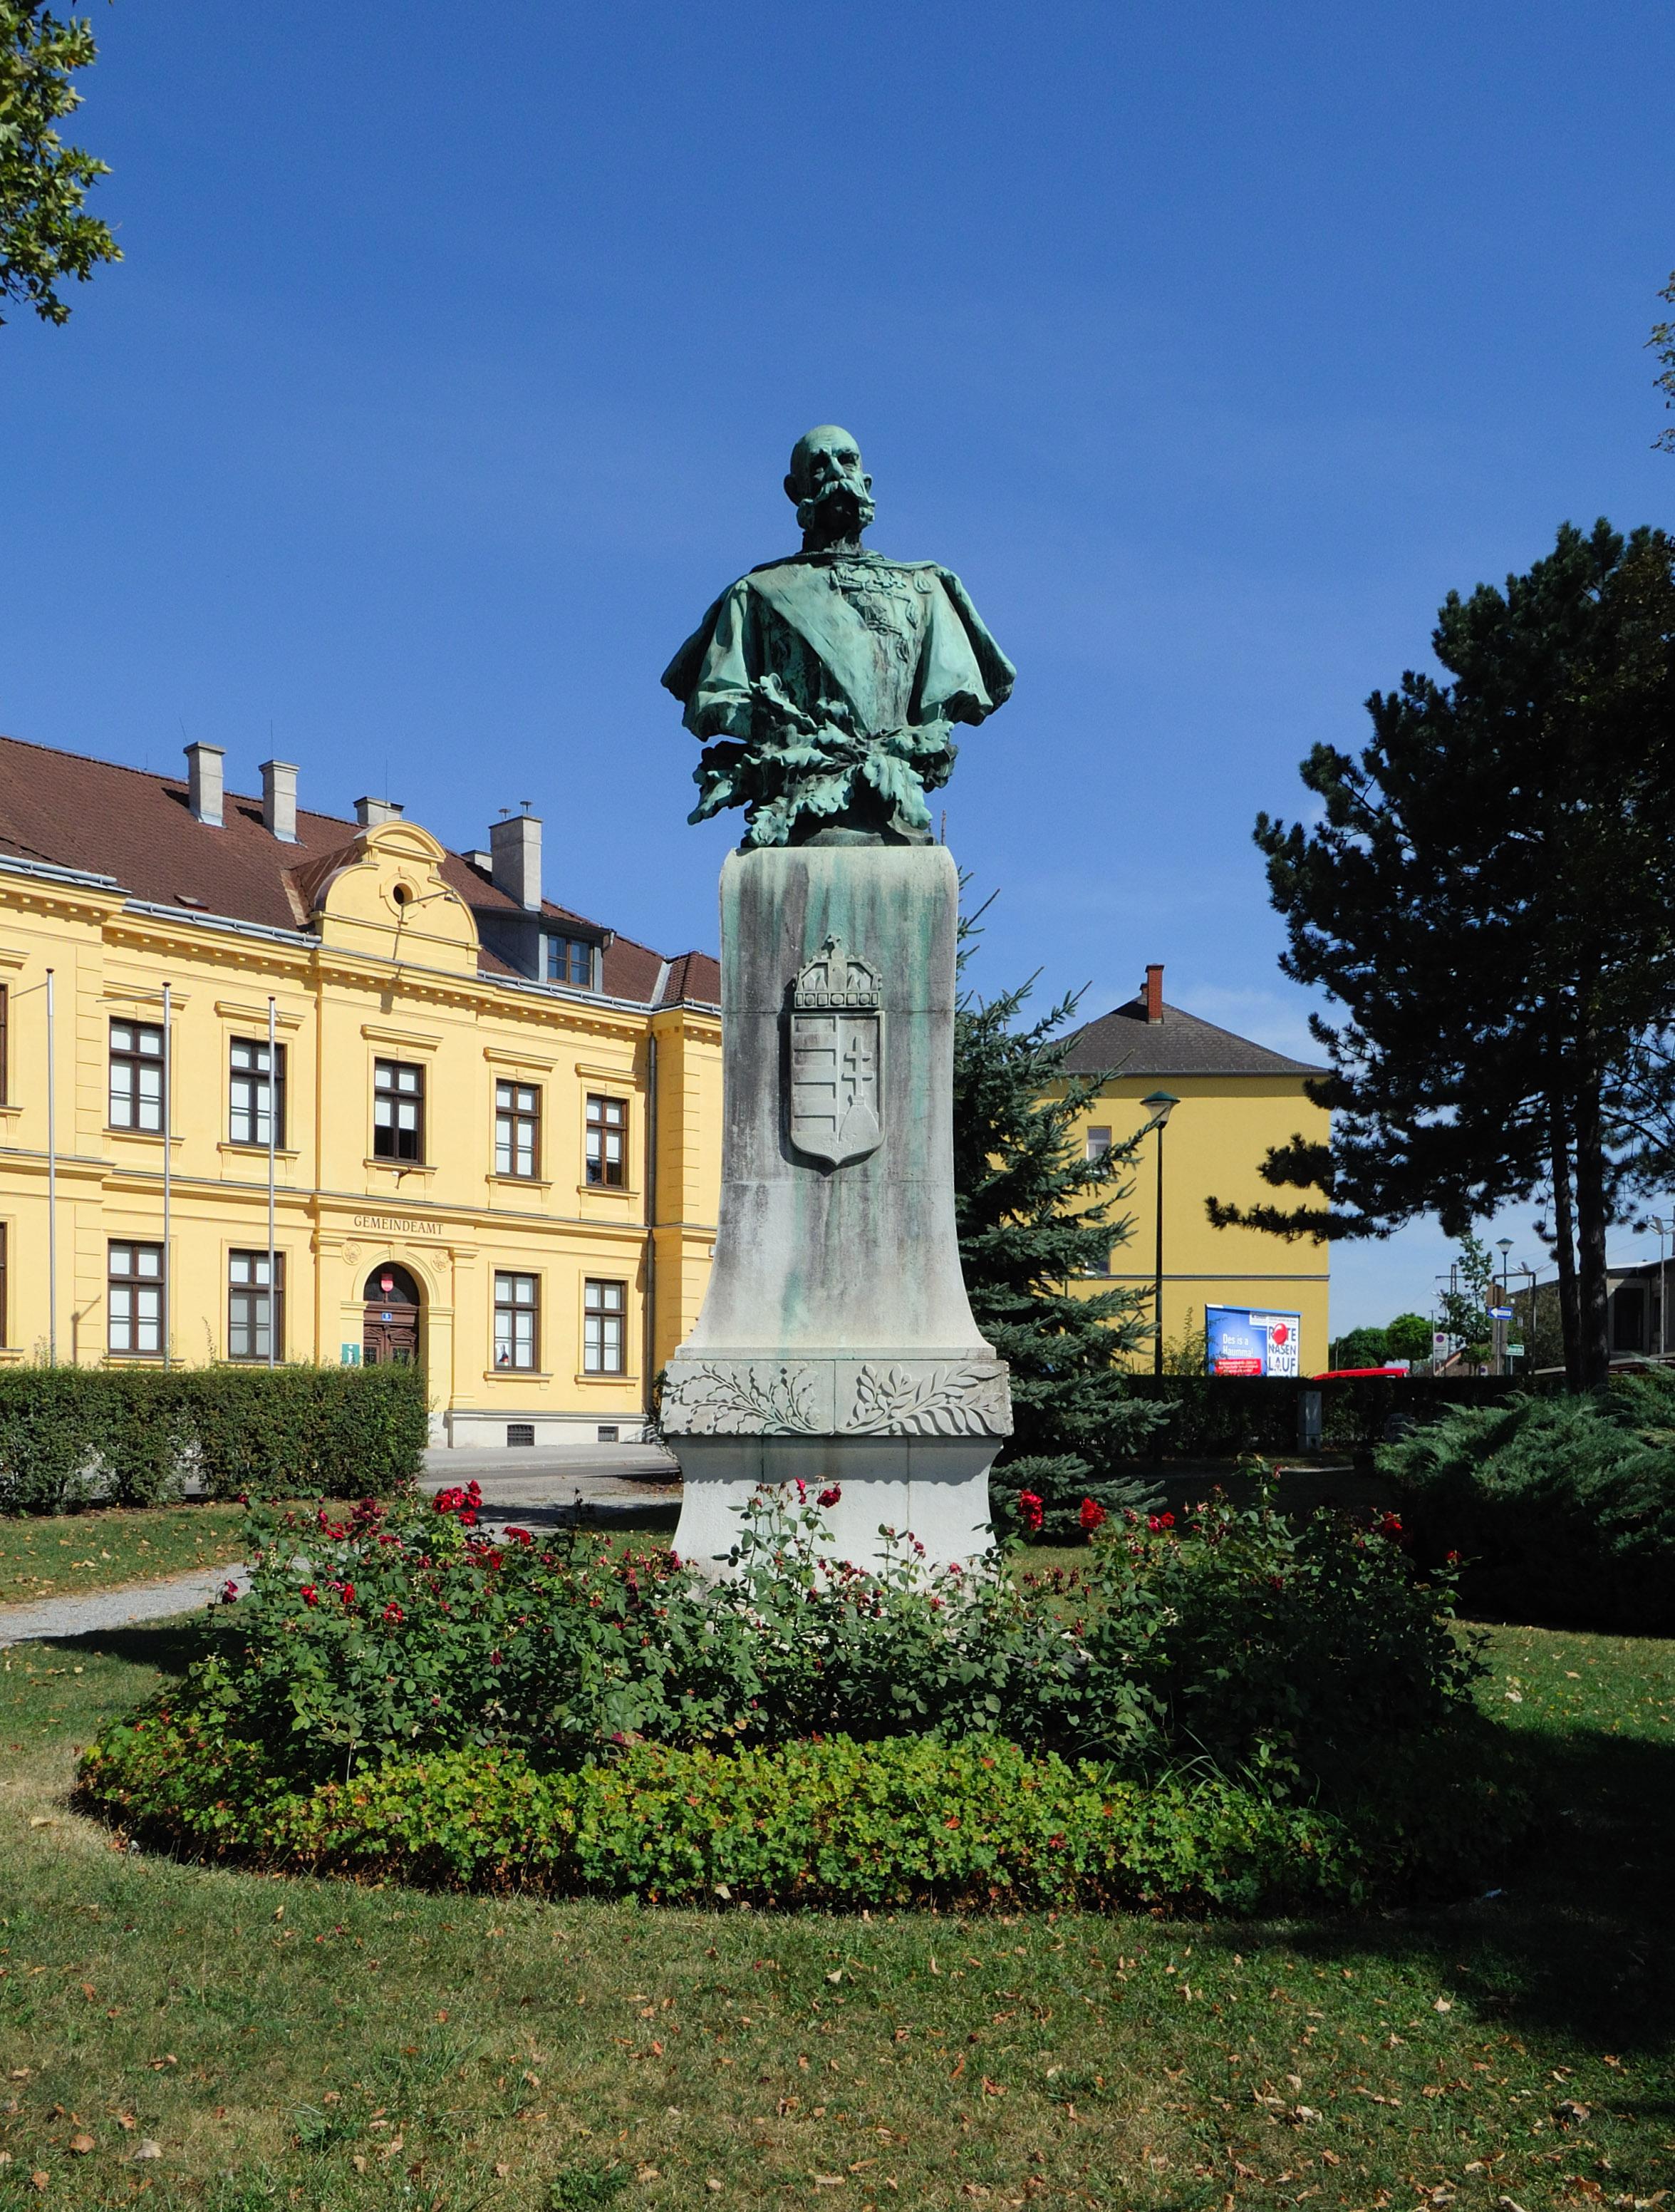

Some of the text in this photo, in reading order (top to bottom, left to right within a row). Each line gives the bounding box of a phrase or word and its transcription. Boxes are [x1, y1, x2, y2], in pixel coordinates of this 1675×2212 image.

[354, 1215, 443, 1235] GEMEINDEAMT
[1223, 1333, 1235, 1345] Des
[1237, 1335, 1243, 1345] is
[1268, 1343, 1296, 1355] NASEN
[1268, 1356, 1296, 1374] LAUF
